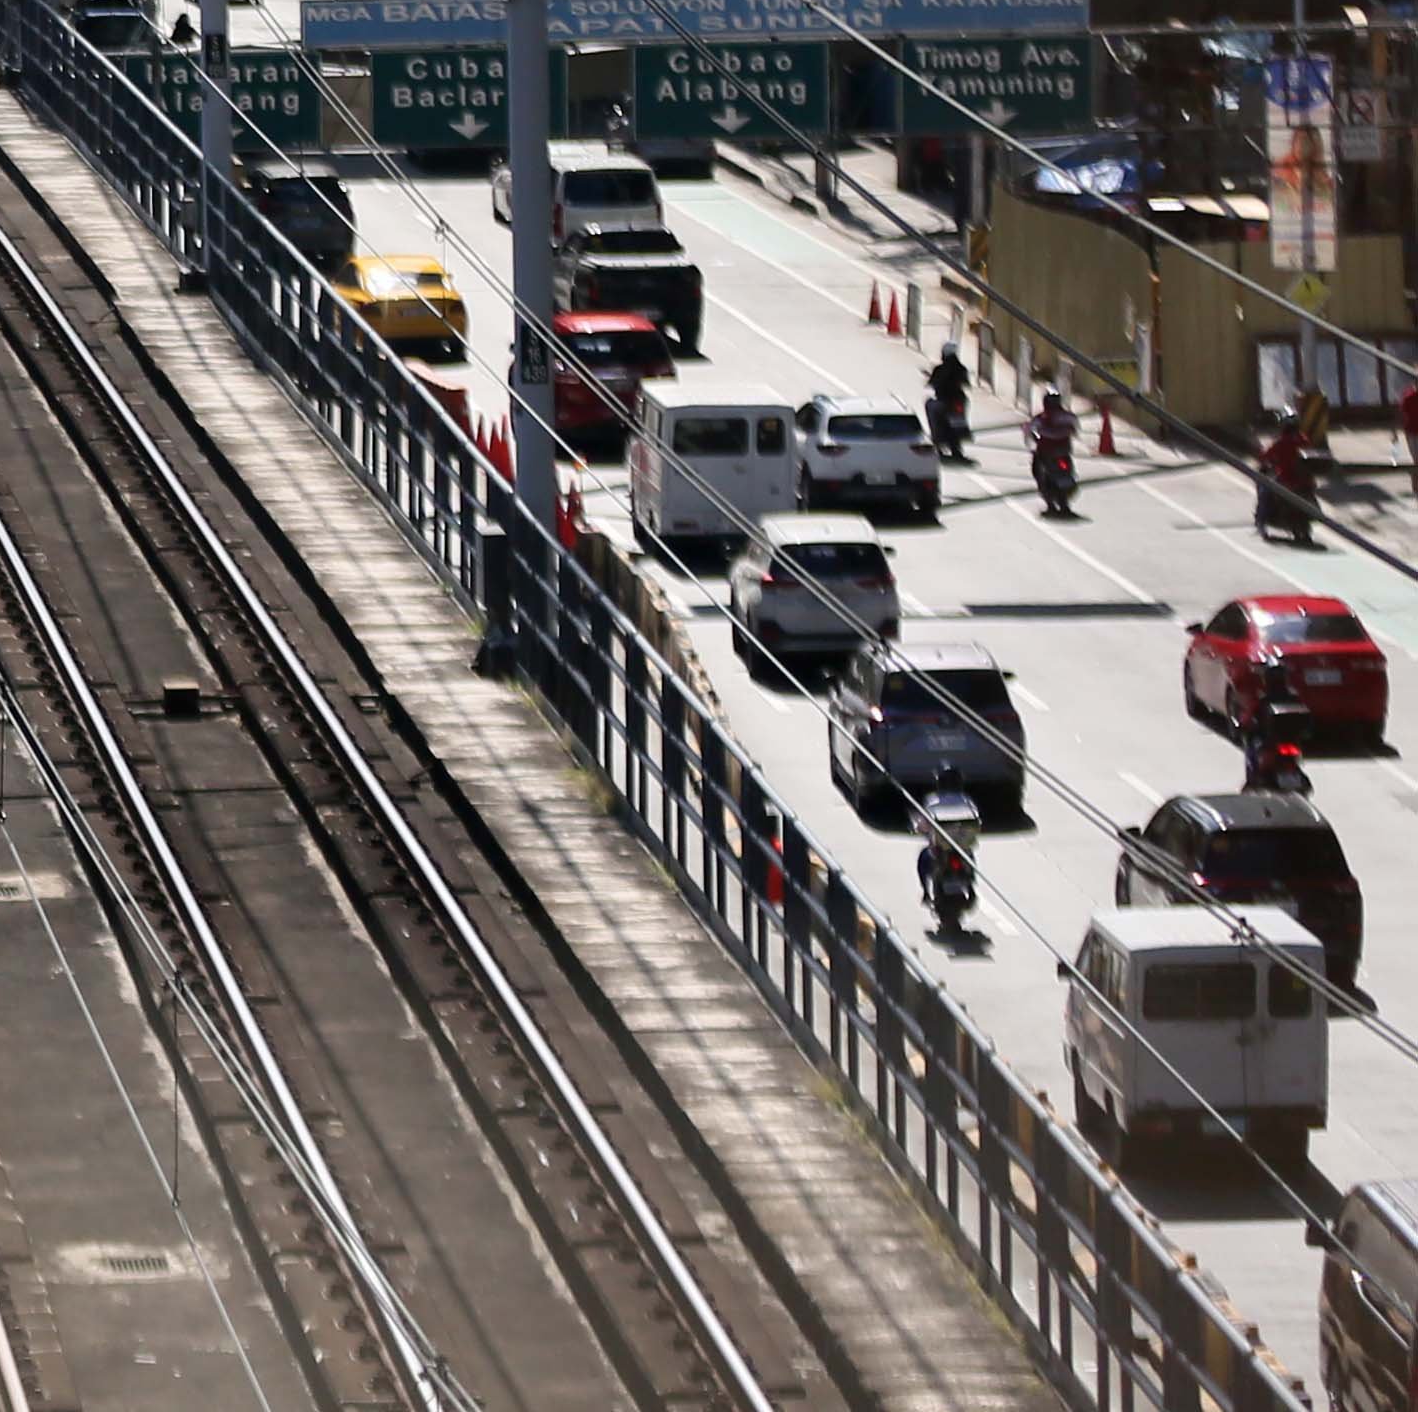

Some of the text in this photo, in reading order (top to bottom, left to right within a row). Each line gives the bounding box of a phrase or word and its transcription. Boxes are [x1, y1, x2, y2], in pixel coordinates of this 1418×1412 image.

[306, 6, 372, 23] MGA
[382, 2, 507, 23] BATAS
[547, 15, 663, 35] APAT
[667, 50, 793, 73] Cubao
[916, 41, 1081, 72] Timog Ave.
[406, 57, 505, 80] Cuba
[392, 85, 505, 109] Baclar
[919, 72, 1076, 100] Kamuning
